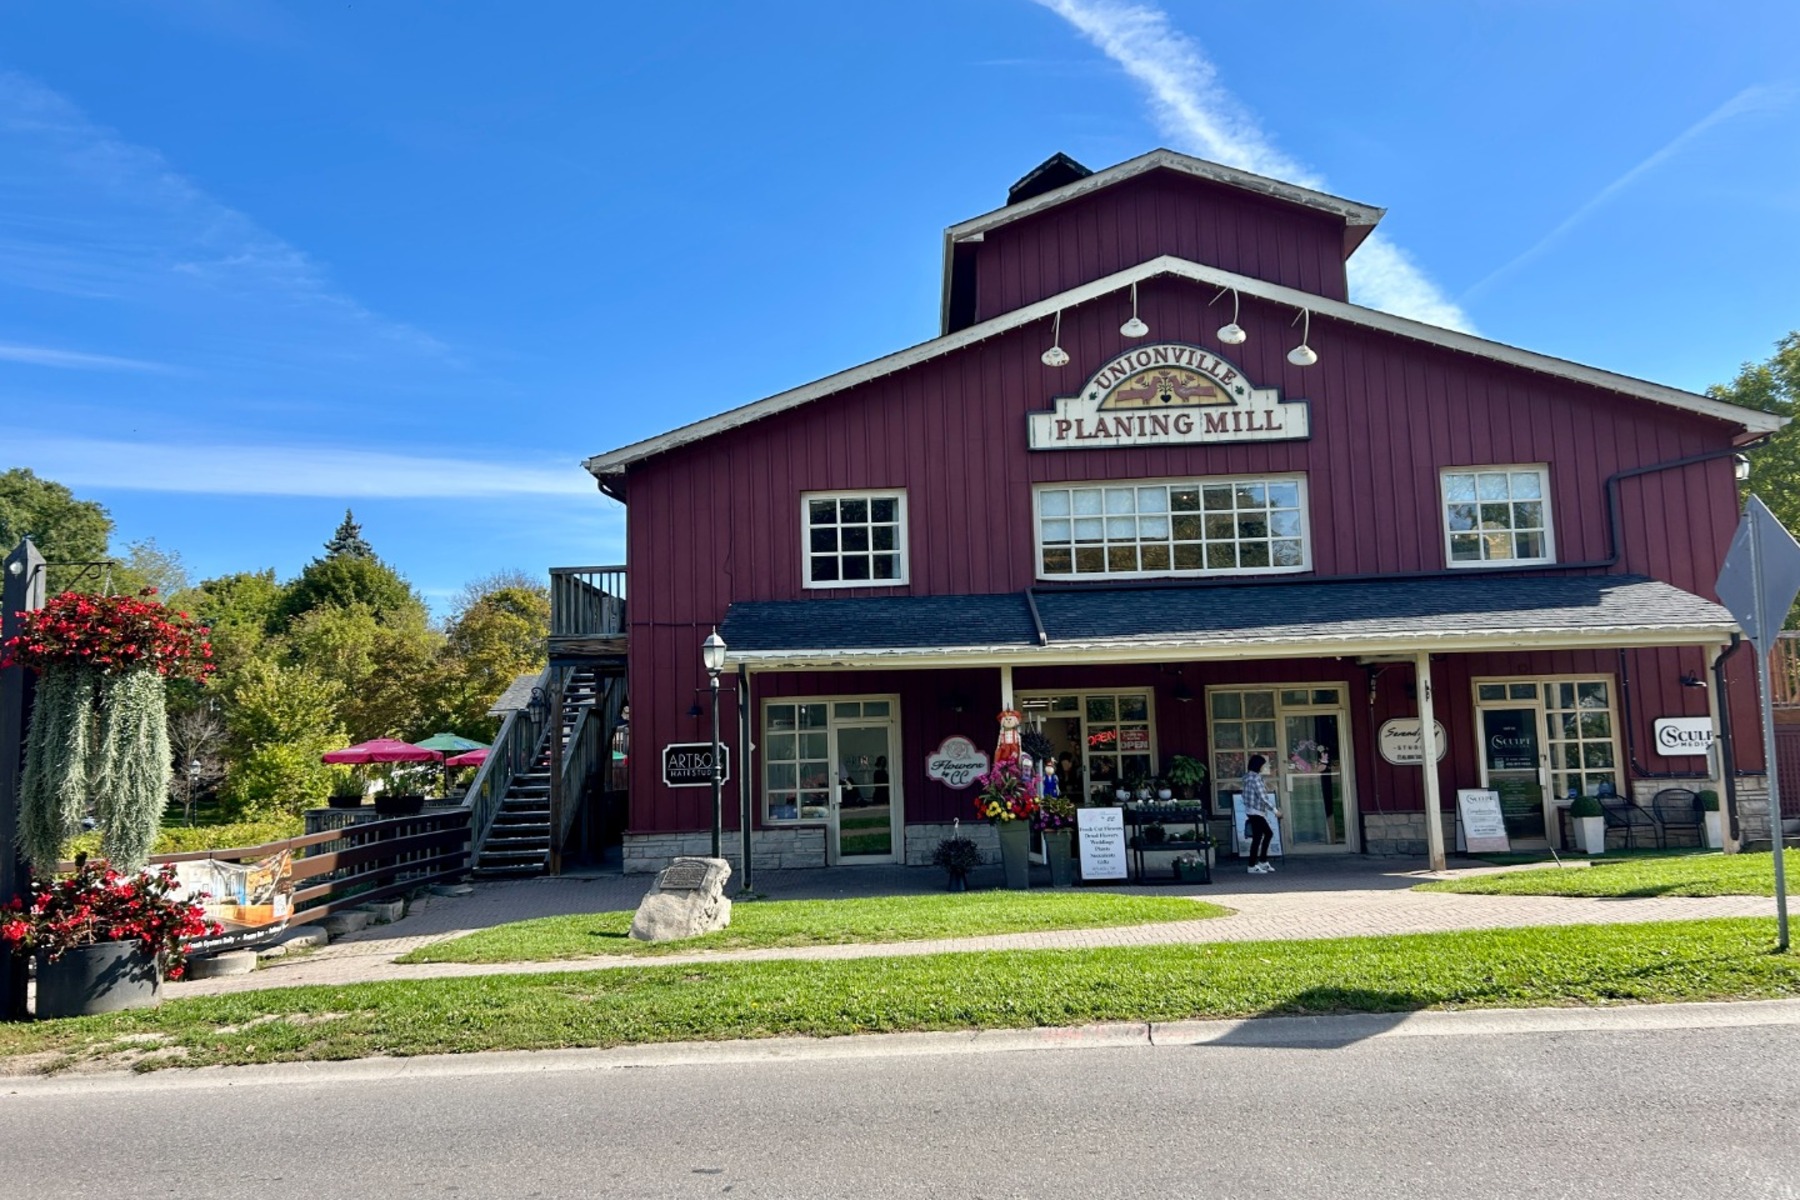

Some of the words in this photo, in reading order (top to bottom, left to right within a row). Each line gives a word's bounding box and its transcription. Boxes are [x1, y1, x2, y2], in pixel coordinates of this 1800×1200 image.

[1094, 346, 1237, 390] UNIONVILLE
[1055, 413, 1194, 441] PLANING
[1204, 409, 1283, 434] MILL
[1088, 729, 1117, 746] OPEN
[1121, 740, 1149, 750] OPEN
[1660, 725, 1713, 748] SCULP
[931, 760, 985, 770] Flowers
[950, 770, 969, 785] CC
